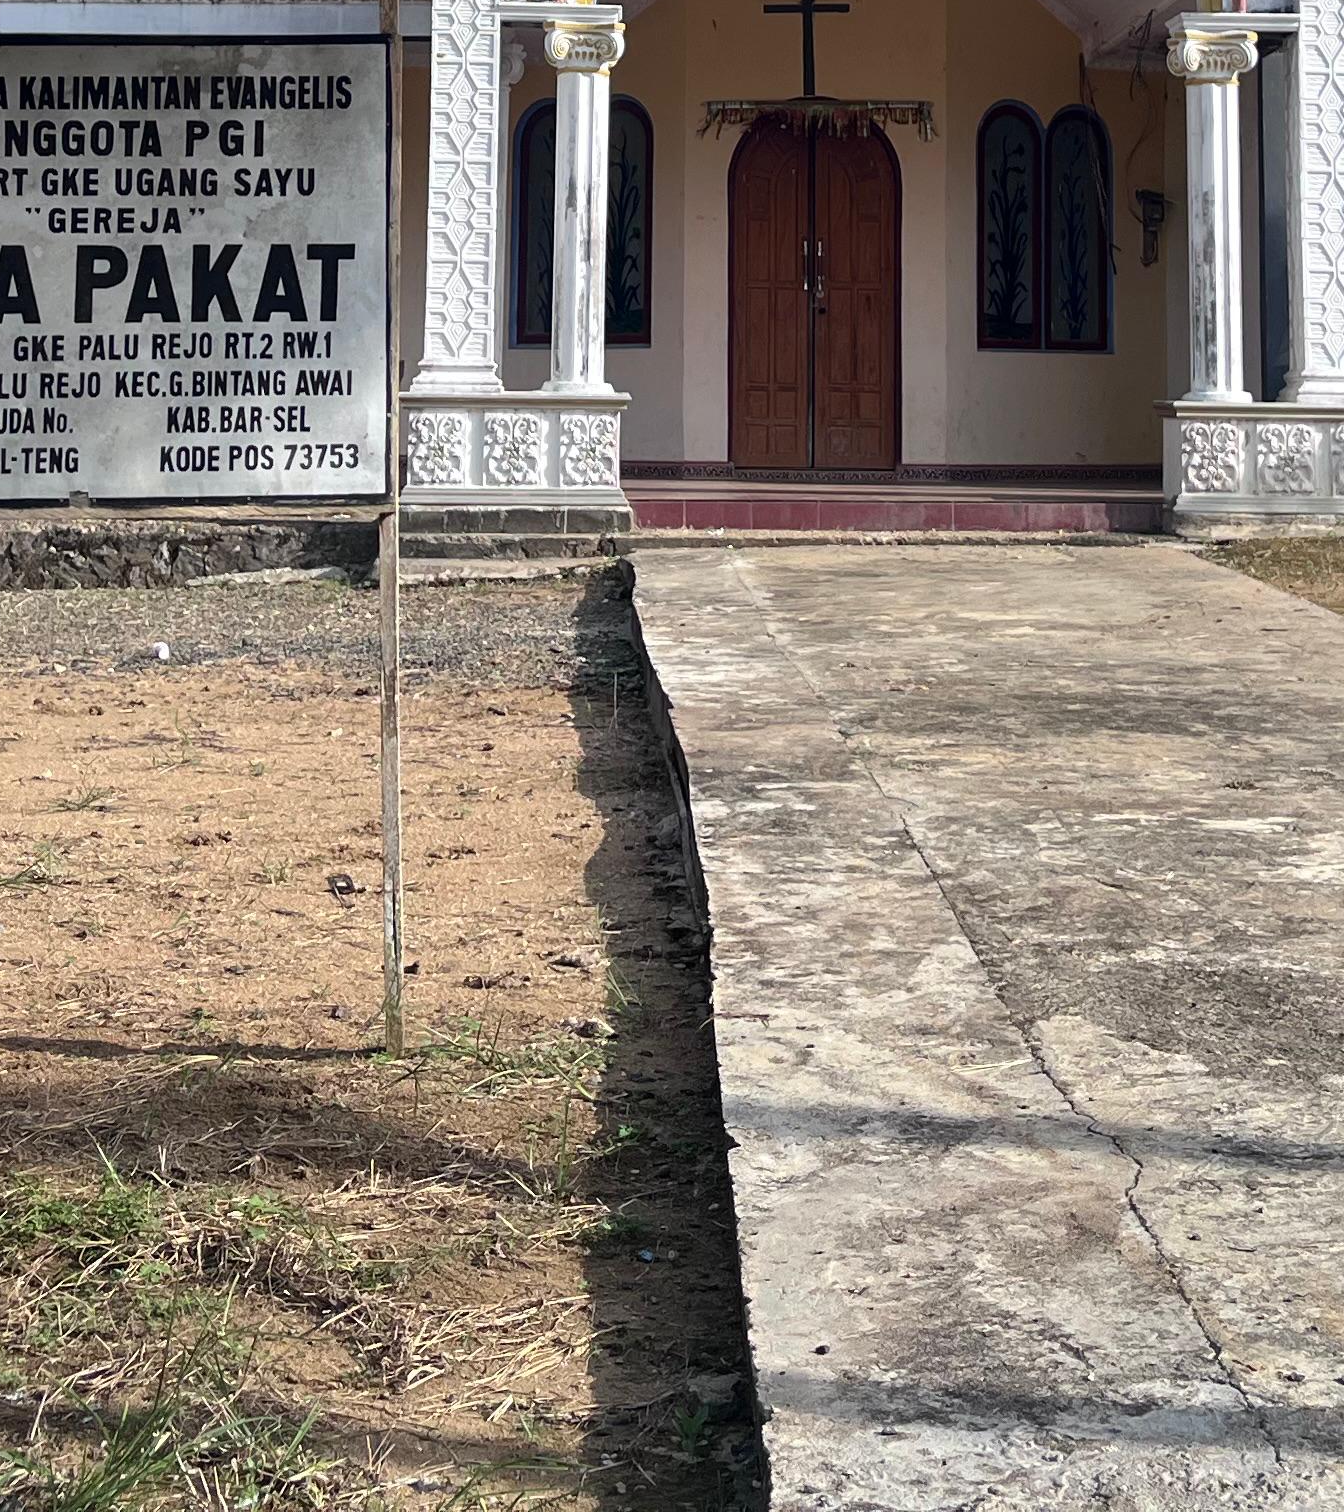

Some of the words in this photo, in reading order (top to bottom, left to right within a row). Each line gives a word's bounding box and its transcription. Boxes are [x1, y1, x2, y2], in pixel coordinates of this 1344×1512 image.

[19, 75, 201, 110] KALIMANTAN
[210, 74, 353, 110] EVANGELIS
[41, 167, 99, 197] GKE
[114, 167, 218, 197] UGANG
[233, 167, 316, 197] SAYU
[73, 243, 356, 324] PAKAT
[12, 334, 66, 362] GKE
[78, 333, 140, 362] PALU
[151, 332, 213, 360] REJO
[224, 332, 273, 360] RT.2
[283, 331, 333, 359] RW.1
[39, 370, 101, 399] REJO
[295, 369, 353, 397] AWAI
[42, 406, 74, 434] No.
[159, 445, 220, 473] KODE
[228, 444, 274, 472] POS
[283, 442, 359, 471] 73753
